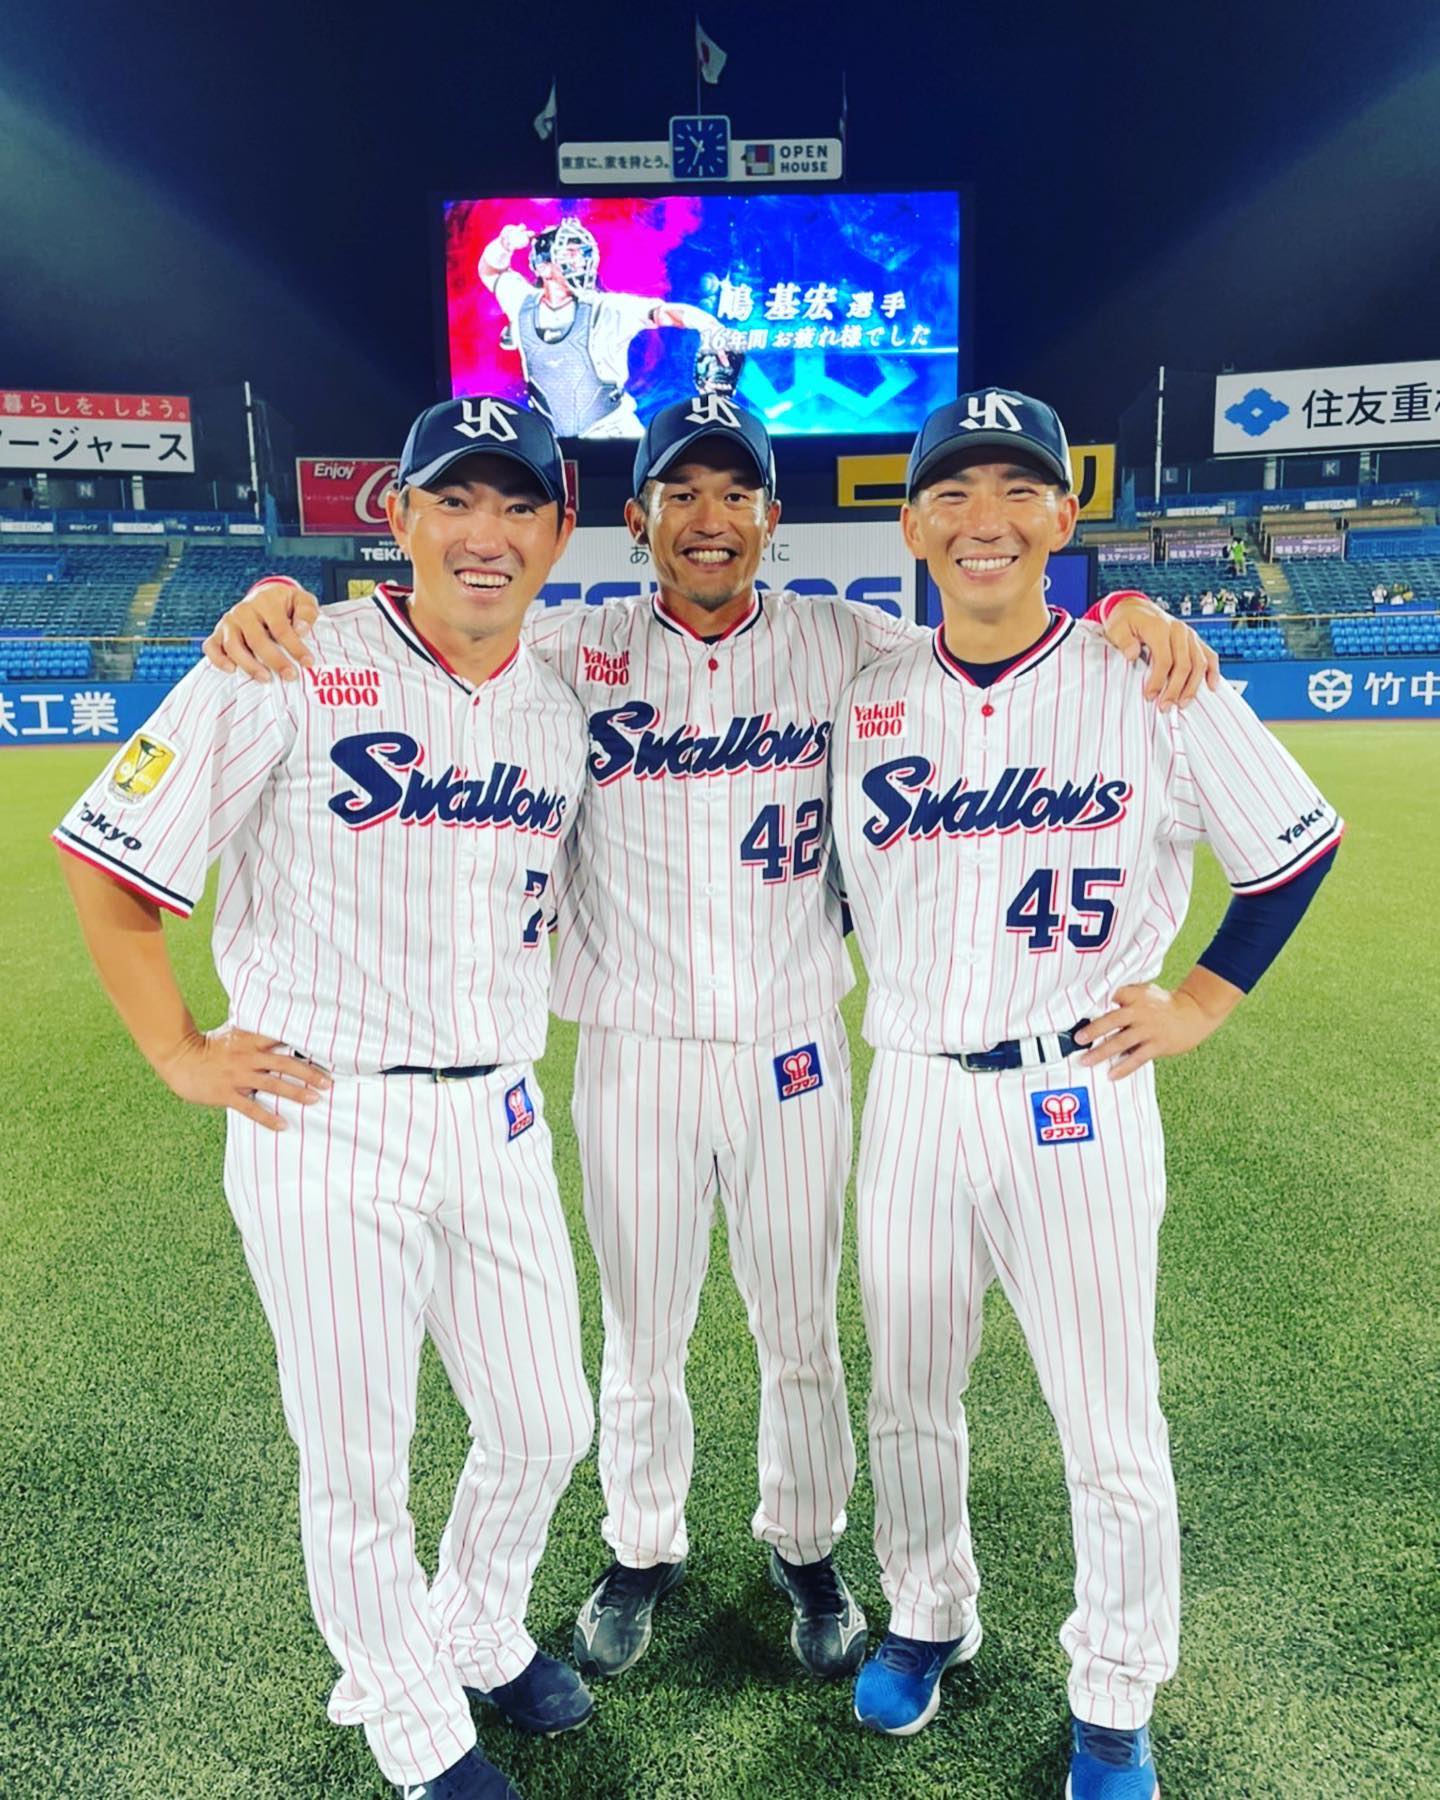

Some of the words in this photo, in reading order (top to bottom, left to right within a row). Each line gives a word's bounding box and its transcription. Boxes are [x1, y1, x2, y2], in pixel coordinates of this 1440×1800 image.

[780, 145, 828, 159] OPEN
[780, 161, 828, 173] HOUSE
[764, 282, 838, 321] 基宏
[846, 291, 906, 319] 選手
[1302, 382, 1440, 429] 住友重
[0, 425, 189, 463] ージャース
[314, 463, 354, 479] Enjoy
[1325, 462, 1337, 474] K
[80, 483, 93, 497] N
[583, 646, 630, 668] Yakult
[306, 666, 381, 688] Yakult
[584, 664, 630, 686] 1000
[314, 687, 379, 707] 1000
[1364, 671, 1440, 706] 竹中
[854, 700, 906, 722] Yakult
[856, 719, 903, 740] 1000
[588, 700, 831, 787] Swallows
[328, 731, 567, 839] Swallows
[862, 756, 1133, 850] Swallows
[740, 797, 824, 885] 42
[1006, 868, 1127, 954] 45
[1042, 1125, 1086, 1140] タフマン
